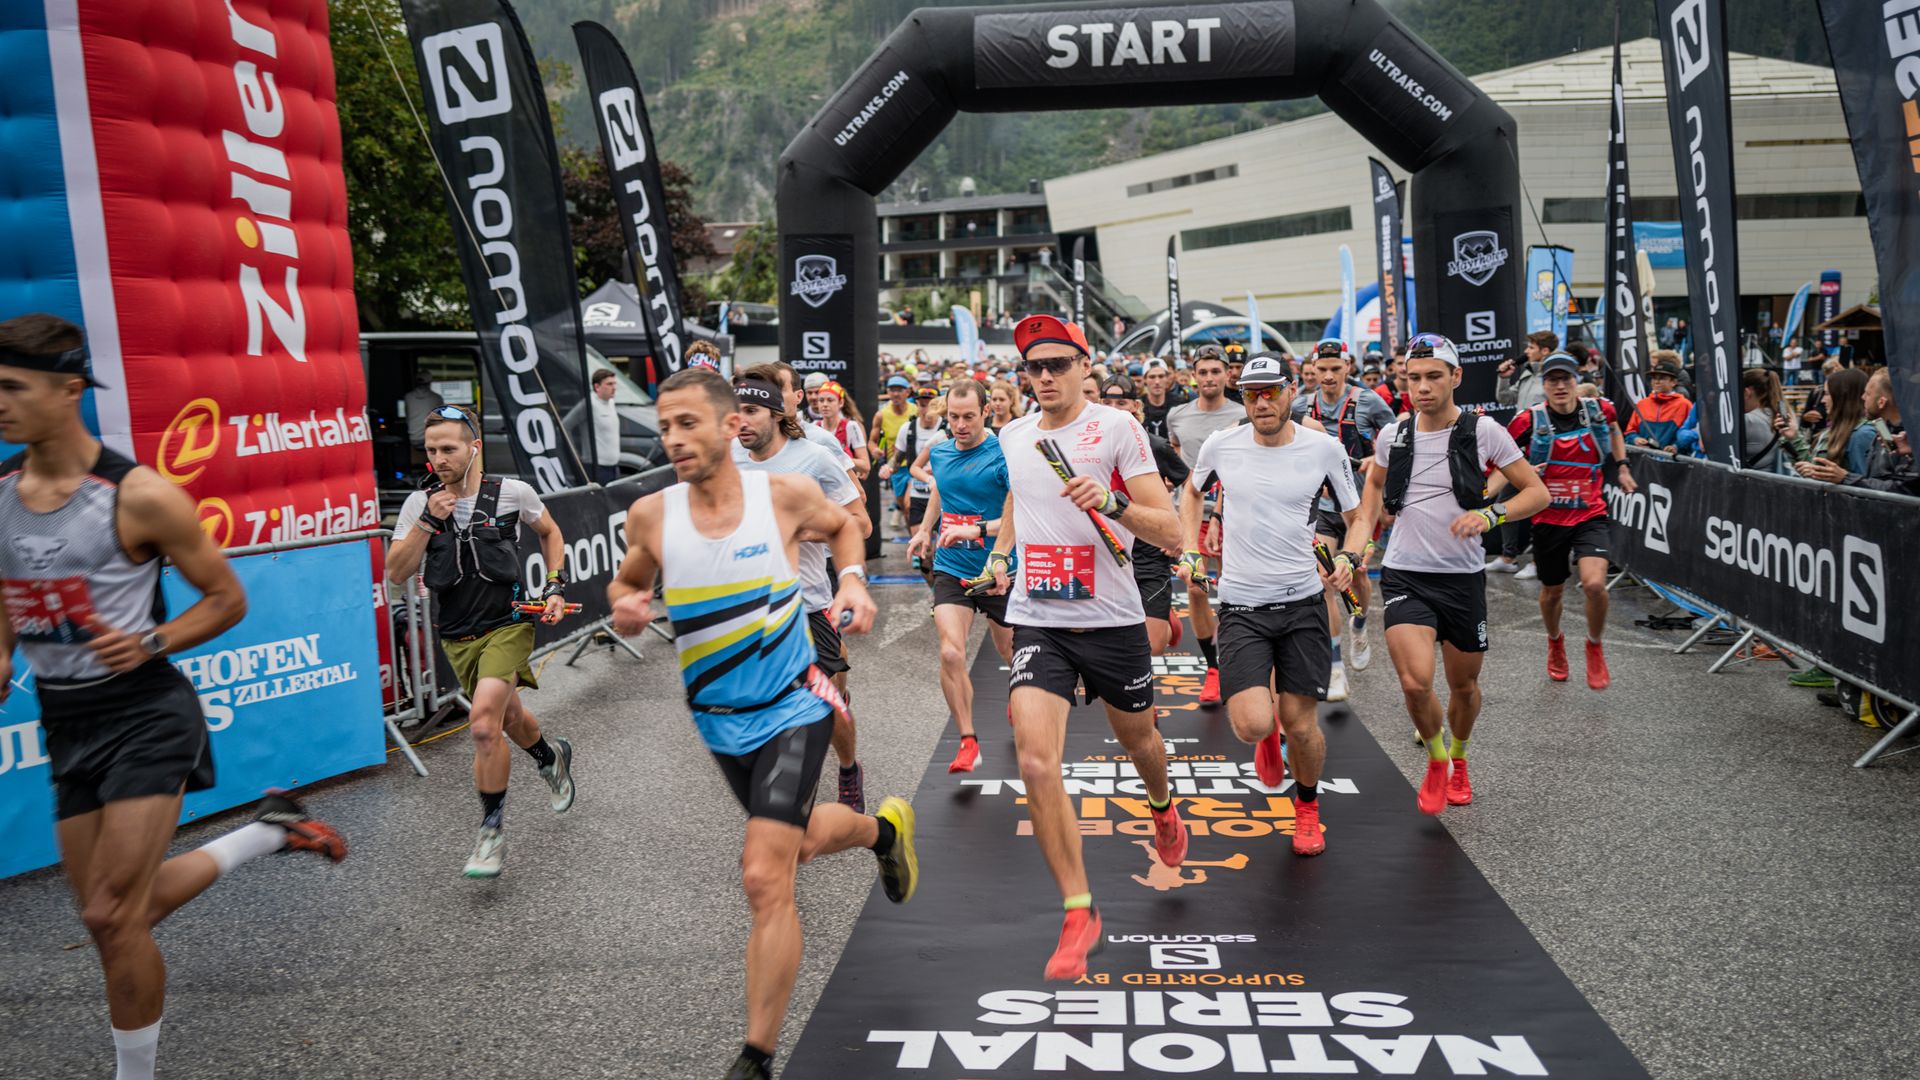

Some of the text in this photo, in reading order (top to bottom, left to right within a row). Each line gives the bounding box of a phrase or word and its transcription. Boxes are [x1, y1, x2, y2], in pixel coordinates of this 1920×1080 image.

[1046, 17, 1221, 69] START
[1369, 48, 1453, 122] ULTRAKS.COM
[834, 70, 910, 147] ULTRAKS.COM
[790, 360, 847, 370] salomon
[1456, 339, 1512, 353] alomon
[1460, 356, 1477, 364] TIME
[1478, 355, 1487, 363] TO
[1704, 515, 1836, 603] salomon
[1027, 575, 1062, 591] 3213
[178, 633, 323, 691] HOFEN
[234, 662, 357, 707] ZILLERTAL
[1107, 934, 1257, 943] salomon
[1074, 973, 1305, 985] SUPPORTED BY
[976, 989, 1415, 1028] SERIES
[866, 1030, 1550, 1077] NATIONAL
